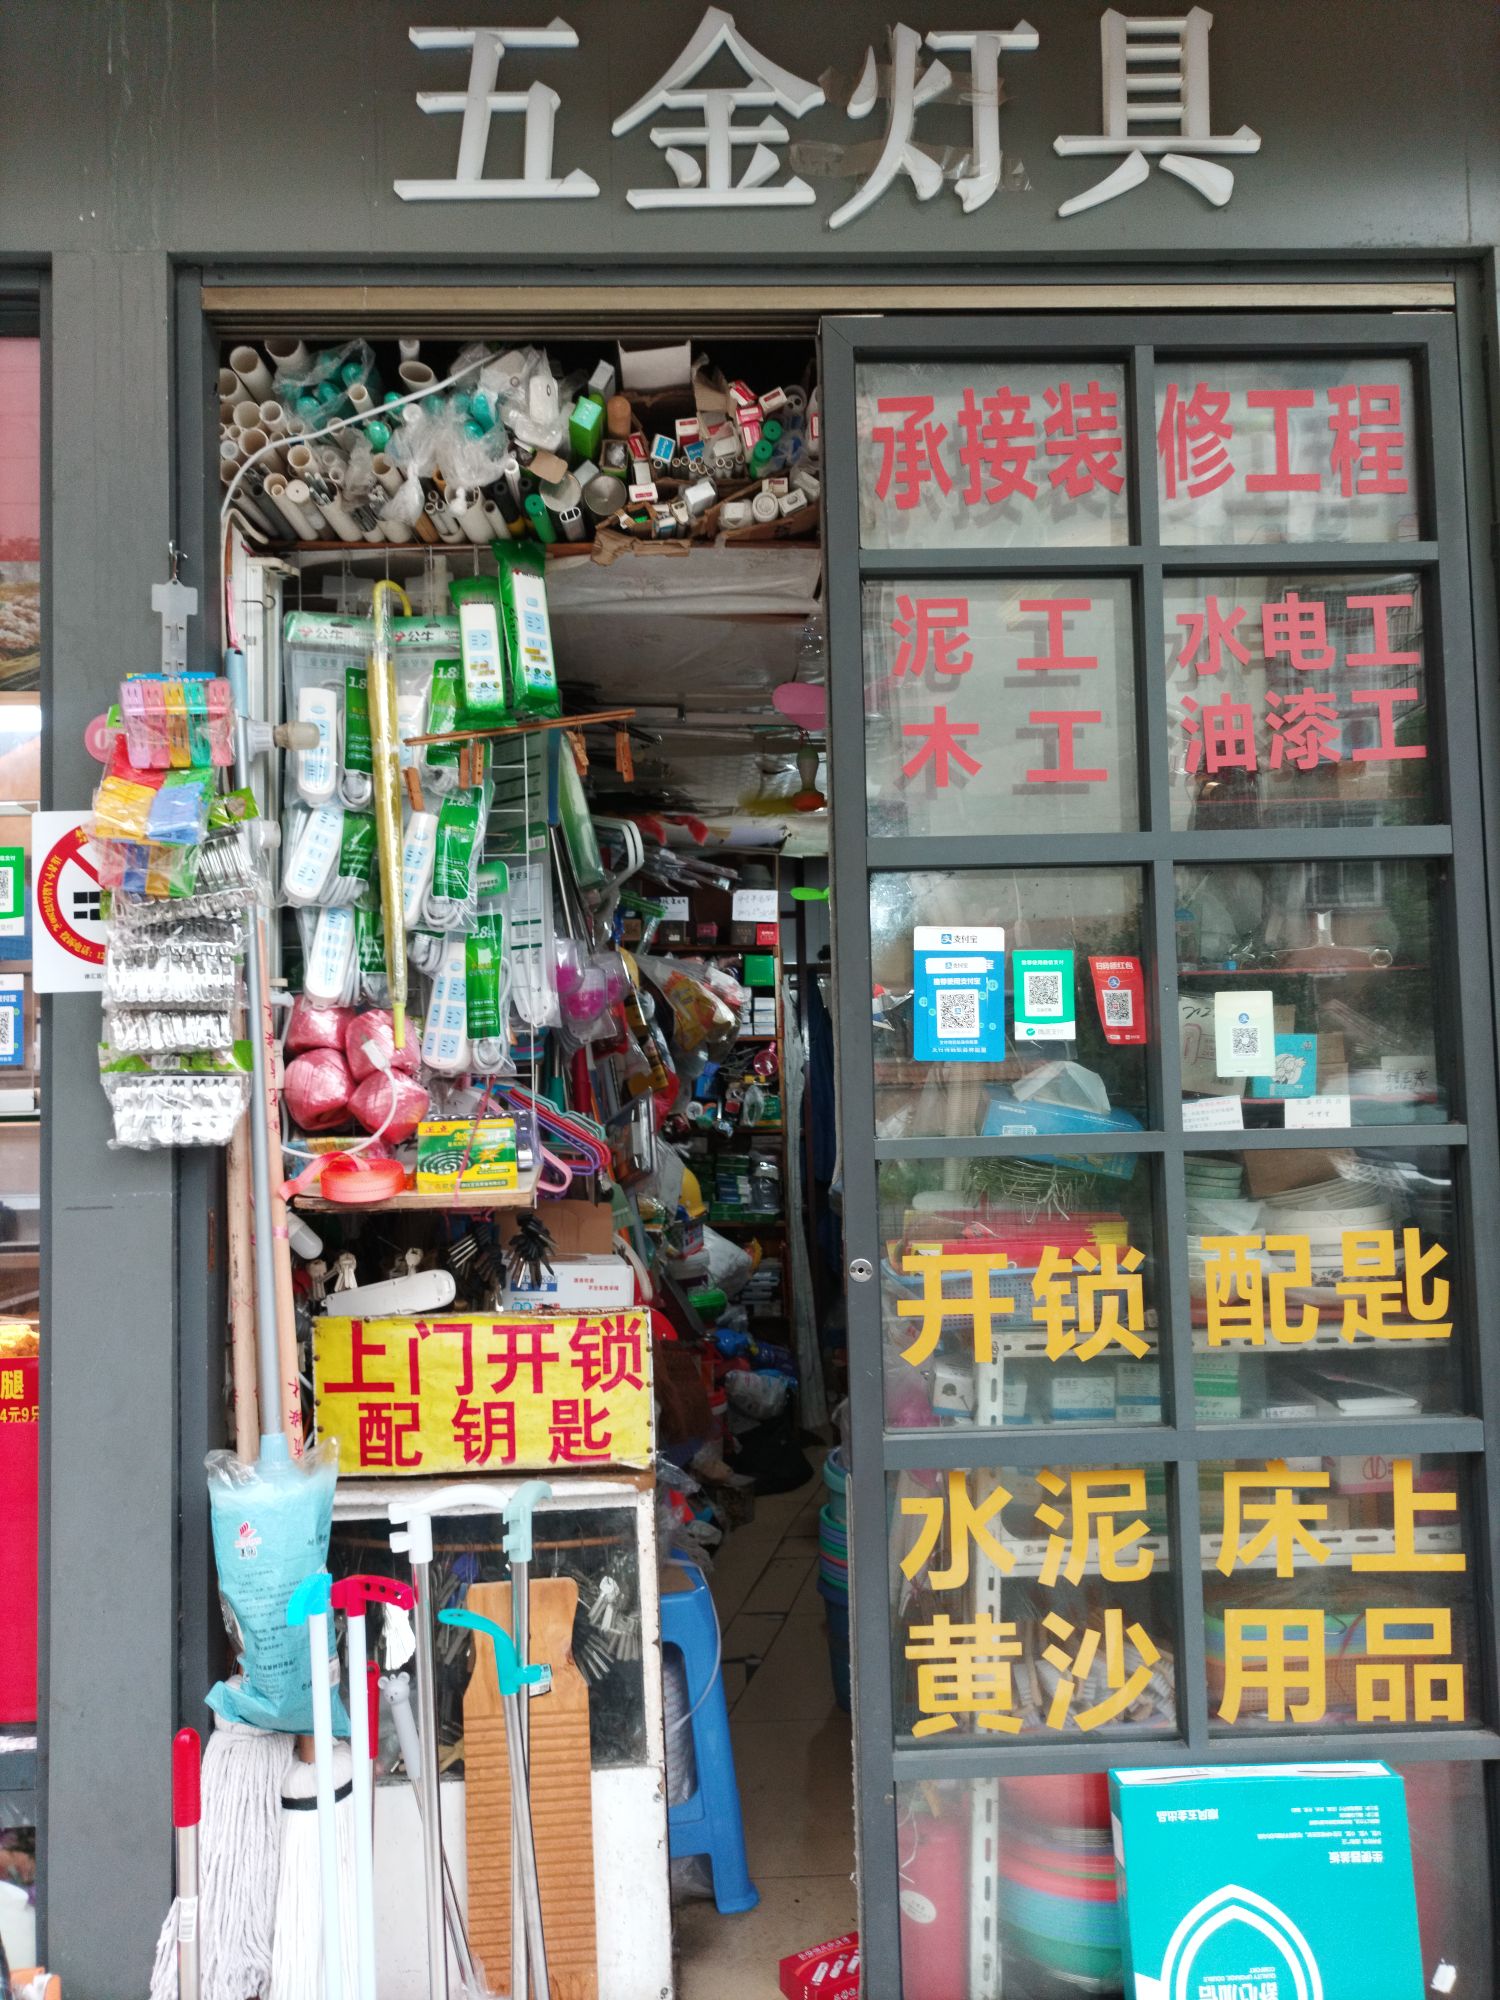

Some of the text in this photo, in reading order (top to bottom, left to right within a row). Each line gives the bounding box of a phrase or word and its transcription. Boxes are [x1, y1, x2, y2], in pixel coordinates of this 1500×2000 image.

[393, 6, 1262, 229] 五金灯具
[890, 594, 1098, 677] 泥工
[1176, 592, 1421, 676] 水电工
[901, 706, 1107, 788] 木工
[1181, 687, 1428, 774] 油漆工
[953, 935, 978, 944] 支付宝
[897, 1243, 1152, 1367] 开锁
[1200, 1227, 1454, 1347] 配匙
[323, 1314, 645, 1396] 上门开锁
[358, 1398, 613, 1467] 配钥匙
[900, 1469, 1155, 1591] 水泥
[1215, 1458, 1467, 1578] 床上
[905, 1608, 1162, 1738] 黄沙
[1216, 1607, 1466, 1725] 用品
